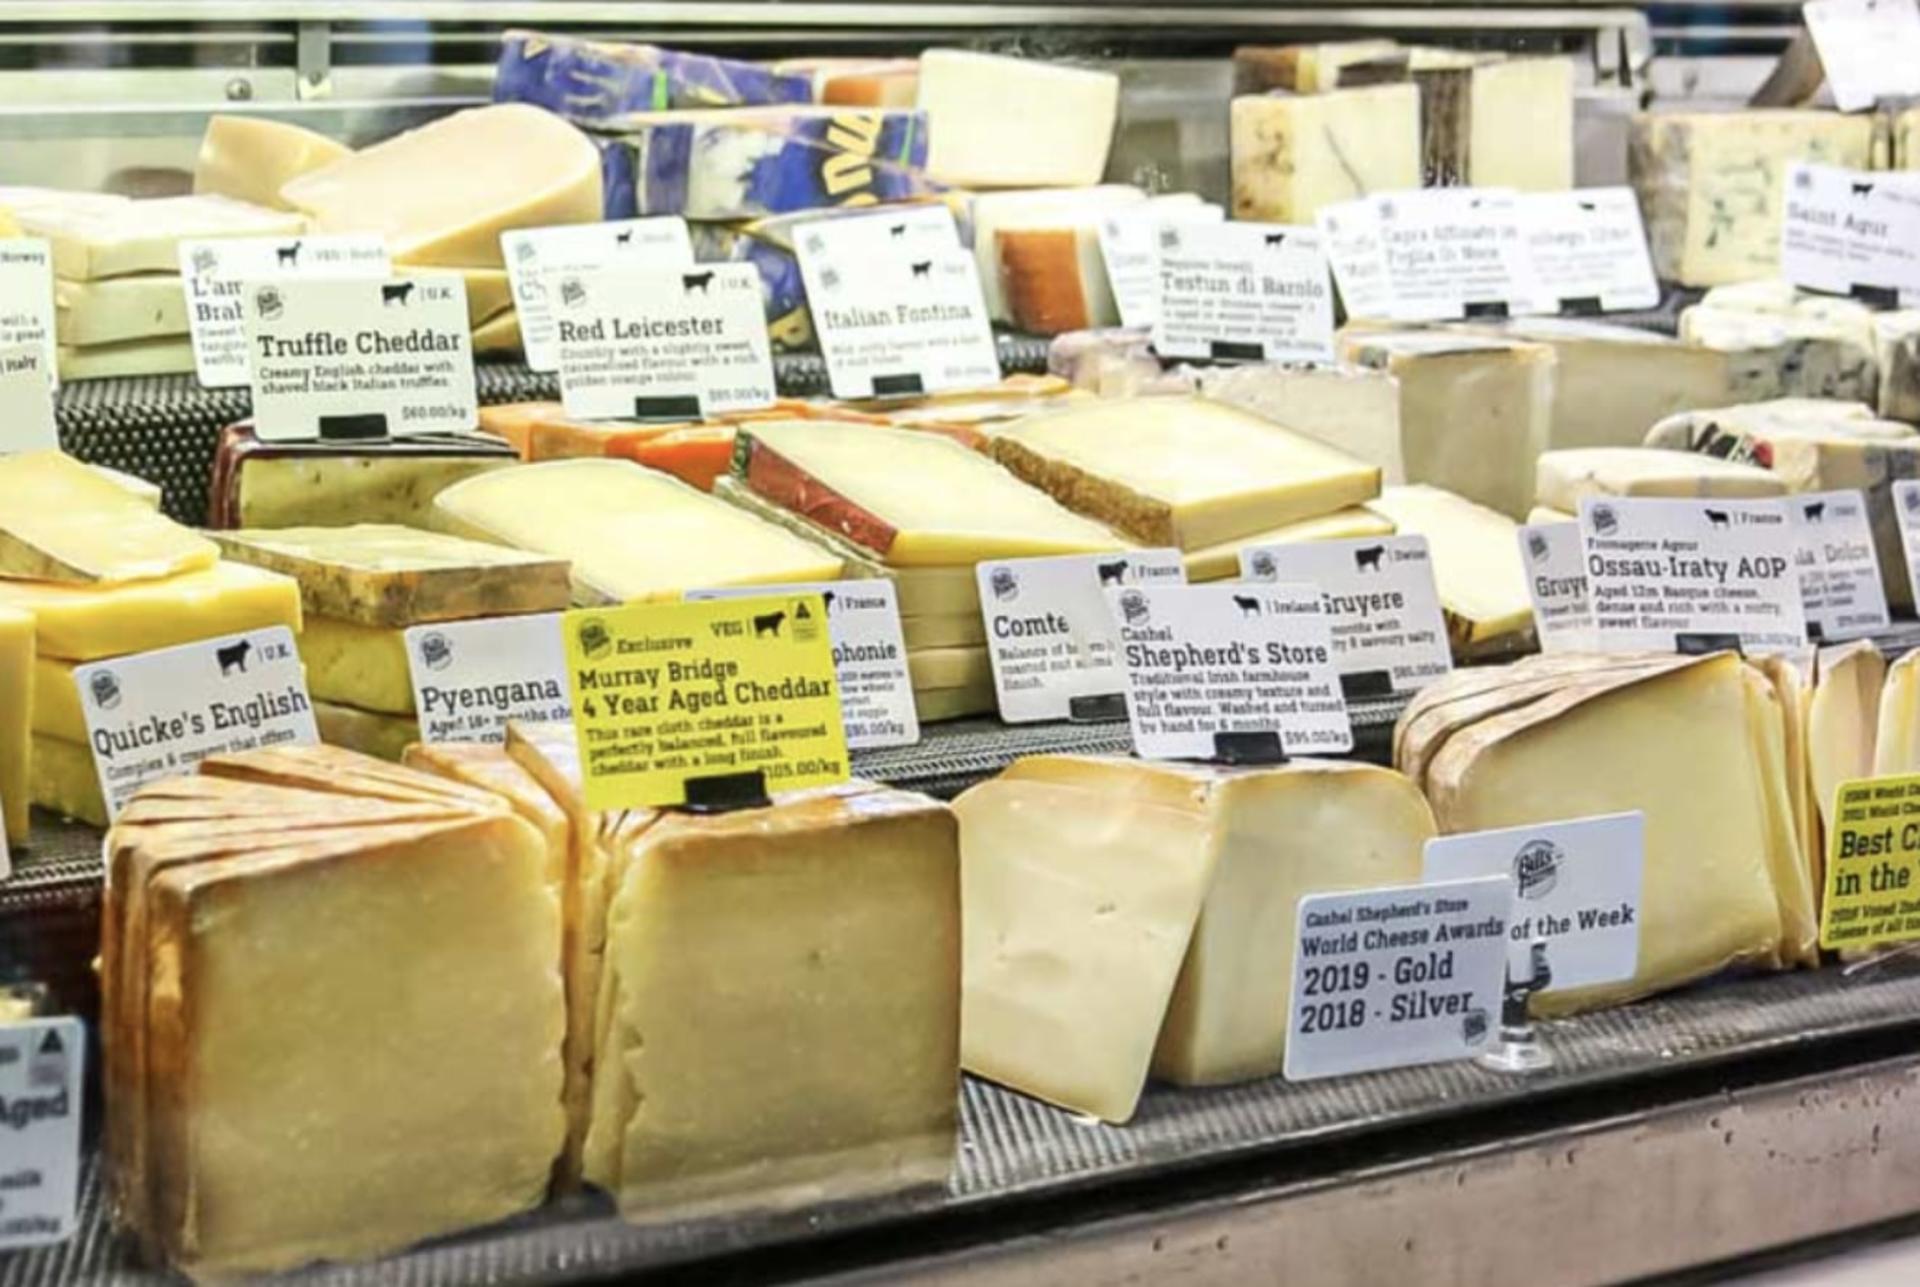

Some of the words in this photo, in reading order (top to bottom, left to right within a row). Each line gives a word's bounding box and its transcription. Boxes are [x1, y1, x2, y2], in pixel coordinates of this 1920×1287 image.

[1788, 202, 1836, 226] Saint
[1844, 212, 1888, 237] Agur
[1159, 271, 1230, 293] Testun
[1237, 275, 1255, 294] di
[1262, 277, 1323, 297] Barolo
[558, 319, 605, 342] Red
[613, 316, 725, 338] Leicester
[823, 305, 893, 330] Italian
[896, 303, 974, 324] Fontina
[257, 332, 348, 357] Truffle
[355, 329, 461, 352] Cheddar
[619, 344, 648, 356] with
[652, 346, 660, 355] a
[662, 341, 711, 357] slightly
[714, 341, 751, 351] sweet
[259, 365, 311, 385] Creamy
[315, 362, 365, 378] English
[369, 360, 420, 374] cheddar
[424, 361, 454, 372] with
[690, 355, 719, 367] with
[722, 356, 730, 366] a
[261, 381, 309, 395] shaved
[312, 378, 348, 391] black
[353, 377, 396, 389] Italian
[1588, 554, 1729, 583] Ossau-Iraty
[1737, 556, 1787, 579] AOP
[1595, 586, 1628, 600] Aged
[1596, 600, 1635, 614] dense
[1639, 600, 1665, 613] and
[1668, 600, 1695, 613] rich
[1700, 601, 1730, 614] with
[1121, 626, 1173, 643] Cashel
[1375, 619, 1401, 631] with
[1597, 617, 1638, 629] sweet
[616, 635, 693, 655] Exclusive
[1127, 642, 1260, 671] Shepherd's
[1265, 642, 1328, 665] Store
[578, 667, 660, 691] Murray
[667, 658, 738, 686] Bridge
[1130, 671, 1204, 686] Traditional
[1207, 672, 1239, 684] Irish
[1242, 671, 1310, 683] farmhouse
[421, 679, 561, 714] Pyengana
[583, 697, 596, 718] 4
[602, 693, 659, 717] Year
[668, 682, 728, 713] Aged
[735, 676, 832, 704] Cheddar
[1134, 689, 1167, 704] style
[1170, 687, 1203, 700] with
[1205, 687, 1251, 701] creamy
[1256, 685, 1303, 698] texture
[1307, 684, 1331, 697] and
[1136, 703, 1161, 718] full
[1217, 702, 1271, 715] Washed
[1274, 700, 1298, 714] and
[1301, 700, 1343, 713] turned
[94, 711, 206, 761] Quicke's
[209, 686, 310, 730] English
[586, 727, 619, 741] This
[623, 726, 652, 738] rare
[657, 720, 694, 735] cloth
[697, 715, 754, 731] cheddar
[758, 714, 771, 725] is
[775, 713, 784, 724] a
[1139, 721, 1157, 735] by
[1161, 719, 1195, 733] hand
[1197, 718, 1216, 732] for
[1232, 718, 1281, 731] months
[589, 739, 654, 762] perfectly
[731, 731, 756, 745] full
[760, 723, 828, 742] flavoured
[105, 755, 164, 781] Complex
[229, 737, 257, 752] that
[590, 760, 649, 776] cheddar
[653, 756, 688, 770] with
[691, 755, 701, 766] a
[703, 750, 736, 766] long
[1839, 826, 1894, 859] Best
[1901, 822, 1920, 851] C
[1835, 867, 1861, 896] in
[1869, 862, 1911, 892] the
[1306, 909, 1353, 928] Cashel
[1356, 901, 1431, 924] Shepherd's
[1434, 899, 1469, 914] Store
[1510, 918, 1532, 941] of
[1537, 913, 1569, 937] the
[1577, 903, 1635, 931] Week
[1302, 935, 1359, 958] World
[1363, 925, 1429, 949] Cheese
[1434, 917, 1505, 943] Awards
[1303, 961, 1370, 996] 2019
[1393, 950, 1454, 986] Gold
[1300, 998, 1366, 1034] 2018
[1390, 990, 1474, 1023] Silver
